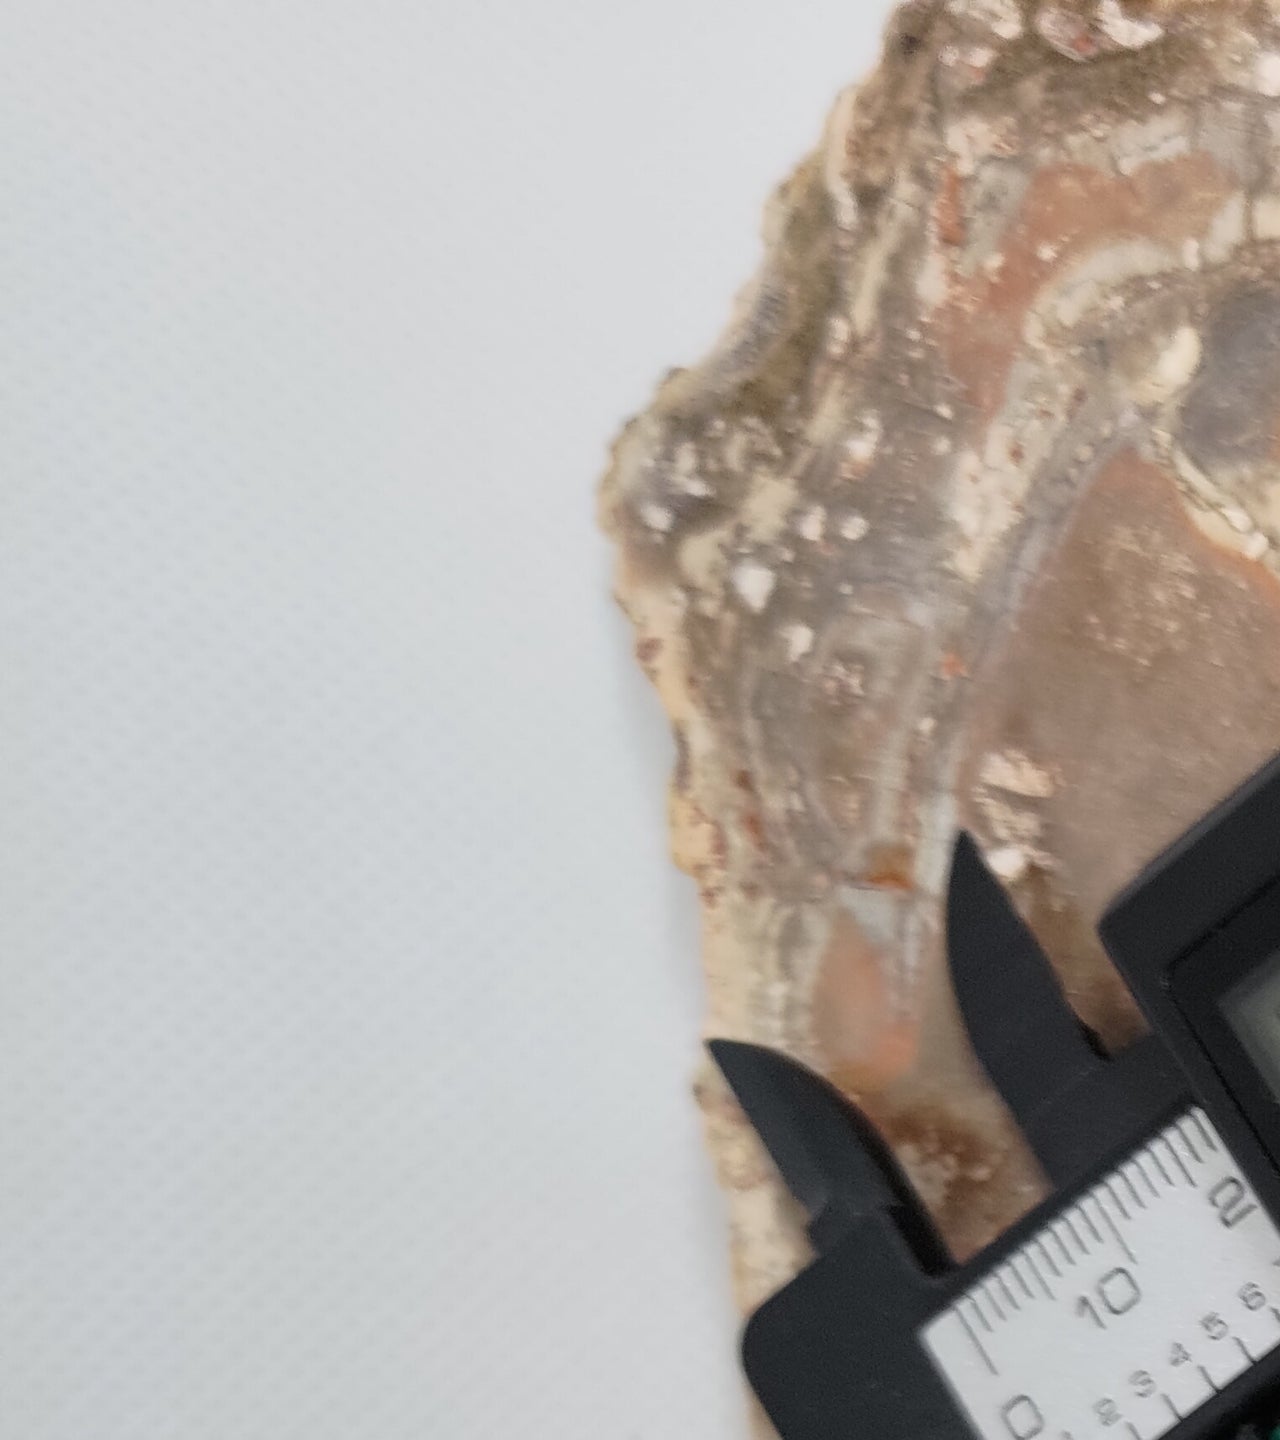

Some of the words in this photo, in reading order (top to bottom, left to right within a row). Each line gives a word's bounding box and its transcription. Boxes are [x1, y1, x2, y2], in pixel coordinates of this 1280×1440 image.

[1073, 1265, 1142, 1331] 10
[1092, 1397, 1124, 1428] 2
[1128, 1369, 1158, 1399] 3
[1168, 1341, 1193, 1369] 4
[1200, 1311, 1231, 1342] 5
[1237, 1281, 1267, 1311] 6
